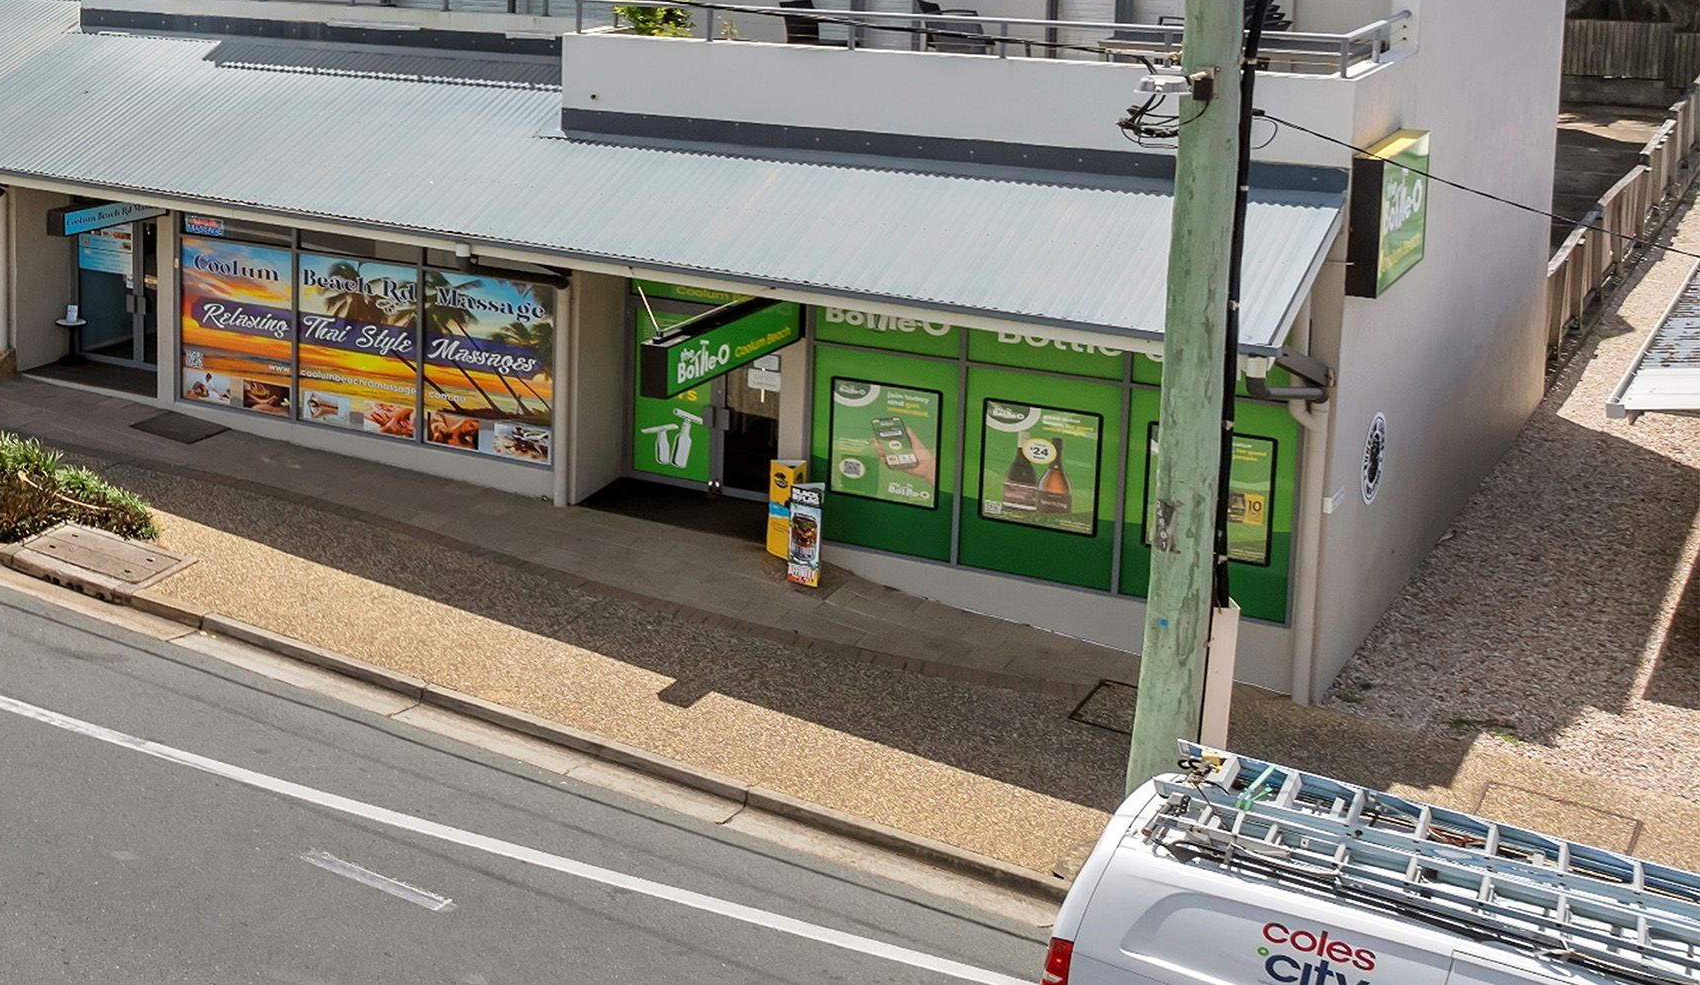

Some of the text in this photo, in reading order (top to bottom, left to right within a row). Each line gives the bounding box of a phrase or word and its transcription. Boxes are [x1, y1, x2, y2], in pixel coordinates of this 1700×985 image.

[194, 255, 546, 322] Coolum Beach Rd Massage
[202, 303, 537, 375] Relaxing Thai Style Massages
[735, 338, 766, 357] Coolum
[766, 327, 792, 346] Beach
[1247, 500, 1262, 513] 10
[1262, 922, 1377, 971] coles
